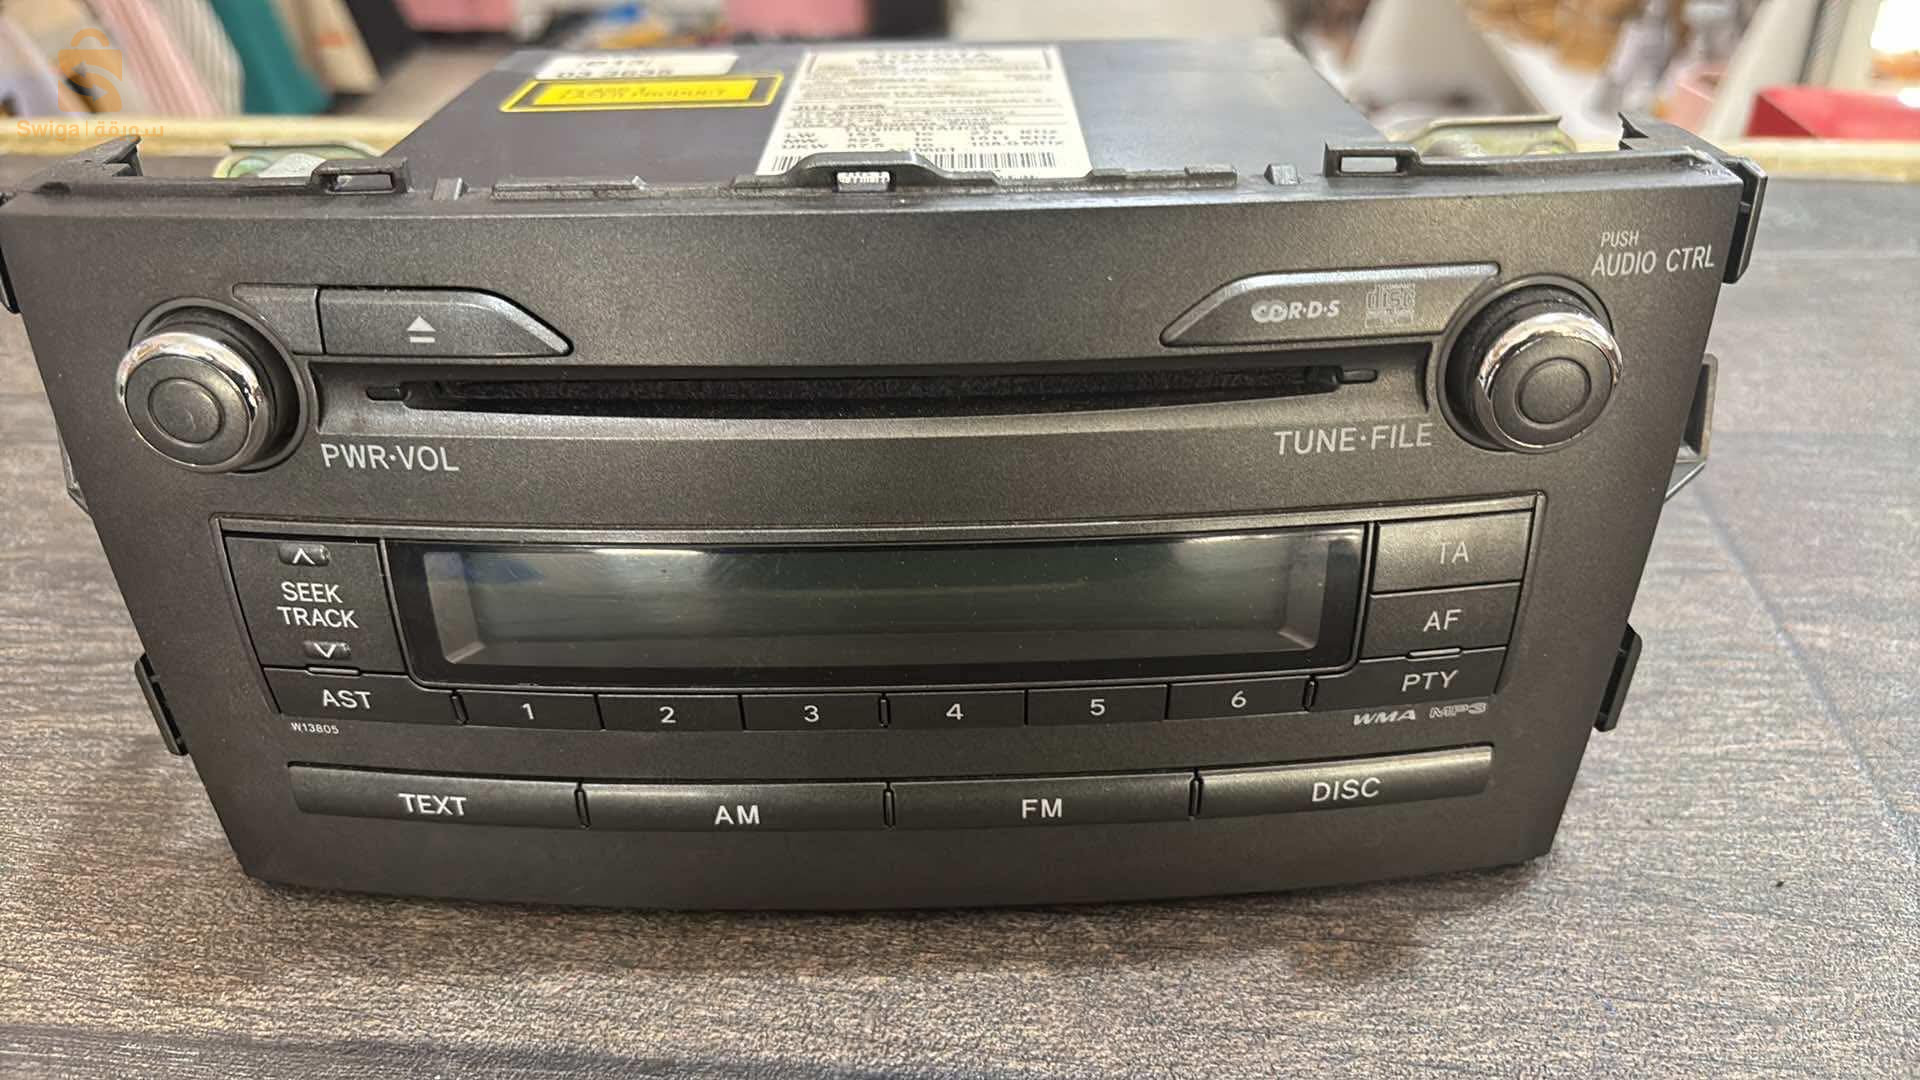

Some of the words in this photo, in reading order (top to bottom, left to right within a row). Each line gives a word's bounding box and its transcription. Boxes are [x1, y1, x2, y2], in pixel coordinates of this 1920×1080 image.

[1600, 230, 1640, 248] PUSH
[1591, 251, 1657, 277] AUDIO
[1665, 243, 1715, 273] CTRL
[1440, 541, 1470, 564] TA
[281, 581, 343, 604] SEEK
[277, 606, 359, 629] TRACK
[1423, 609, 1462, 632] AF
[1401, 670, 1459, 692] PTY
[322, 689, 371, 709] AST
[1089, 698, 1106, 717] 5
[1231, 690, 1247, 709] 6
[521, 702, 535, 720] 1
[658, 705, 677, 724] 2
[803, 704, 820, 723] 3
[946, 703, 964, 721] 4
[1353, 709, 1416, 726] WMA
[1429, 702, 1487, 719] MP3
[1311, 776, 1381, 802] DISC
[398, 792, 467, 816] TEXT
[714, 804, 760, 825] AM
[1021, 798, 1063, 818] FM
